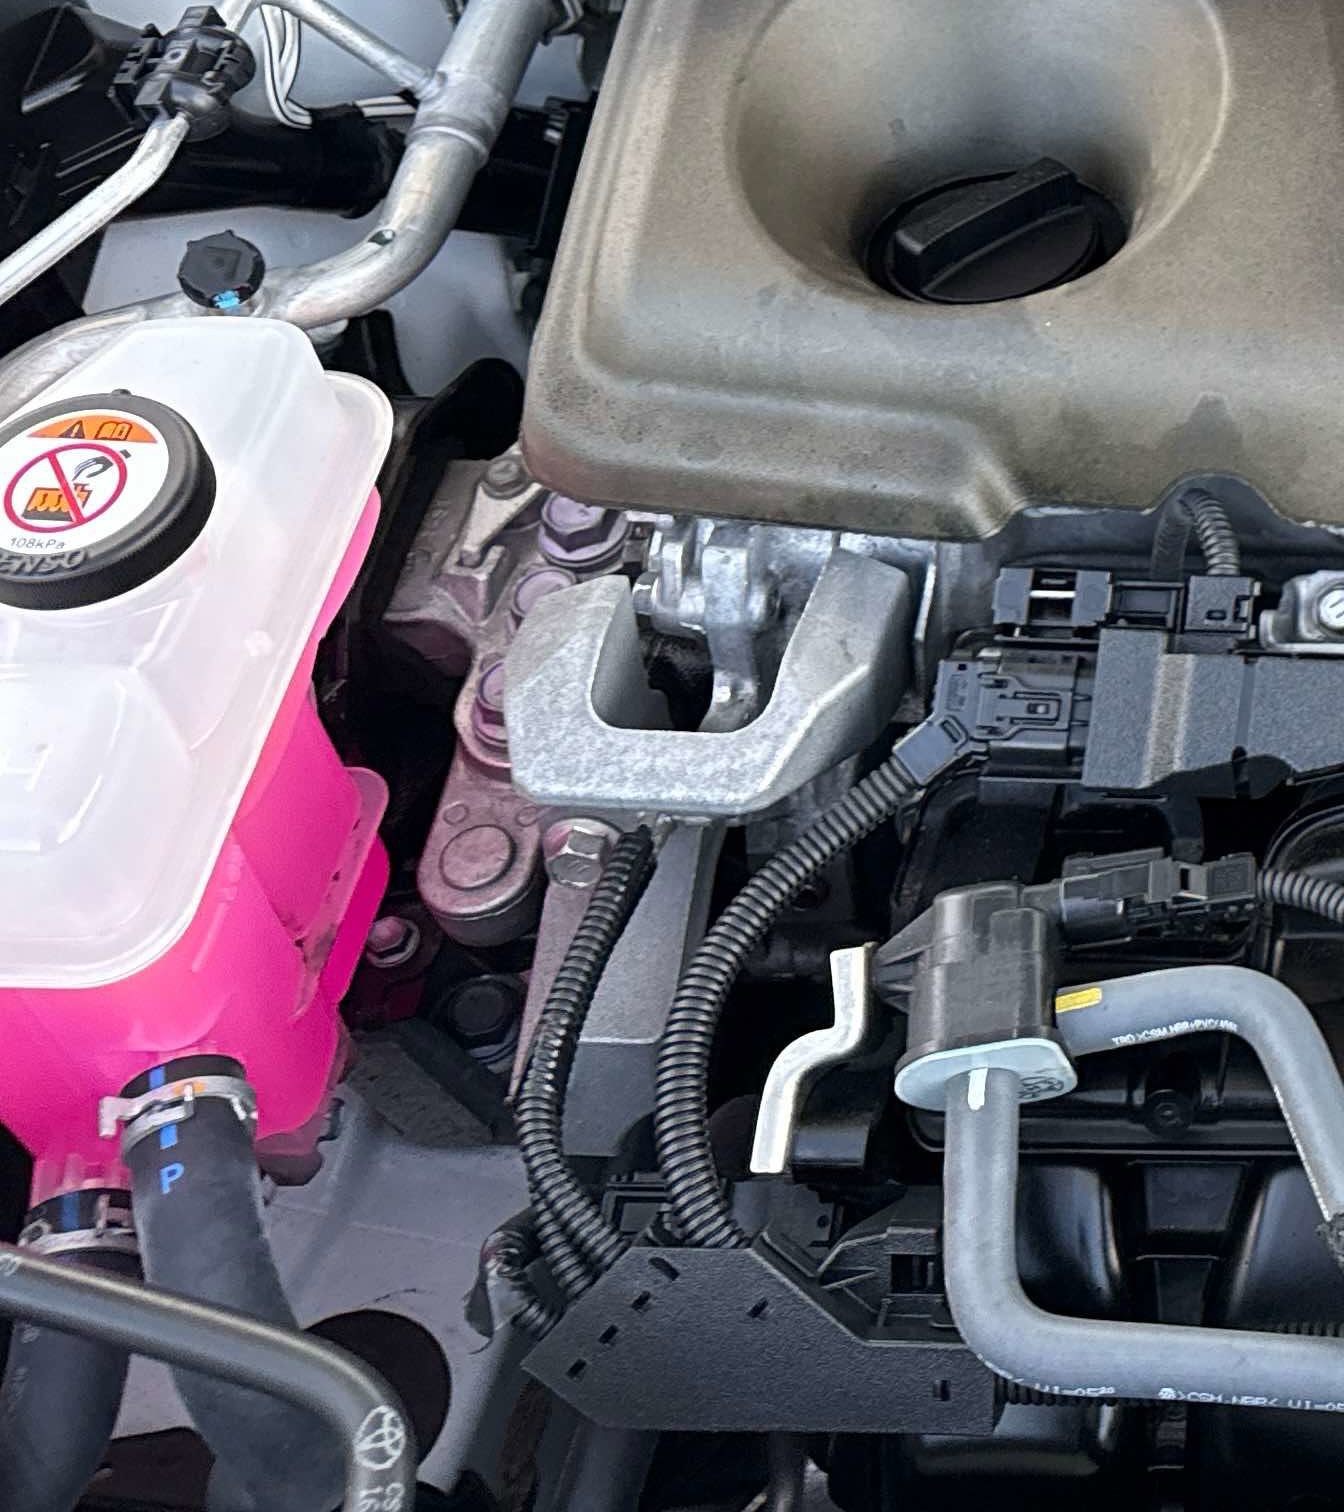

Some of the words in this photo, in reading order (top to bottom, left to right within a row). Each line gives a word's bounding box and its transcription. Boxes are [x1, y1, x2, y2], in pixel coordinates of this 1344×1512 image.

[10, 537, 66, 549] 108kPa
[0, 550, 88, 575] ENSO
[160, 1163, 184, 1194] P
